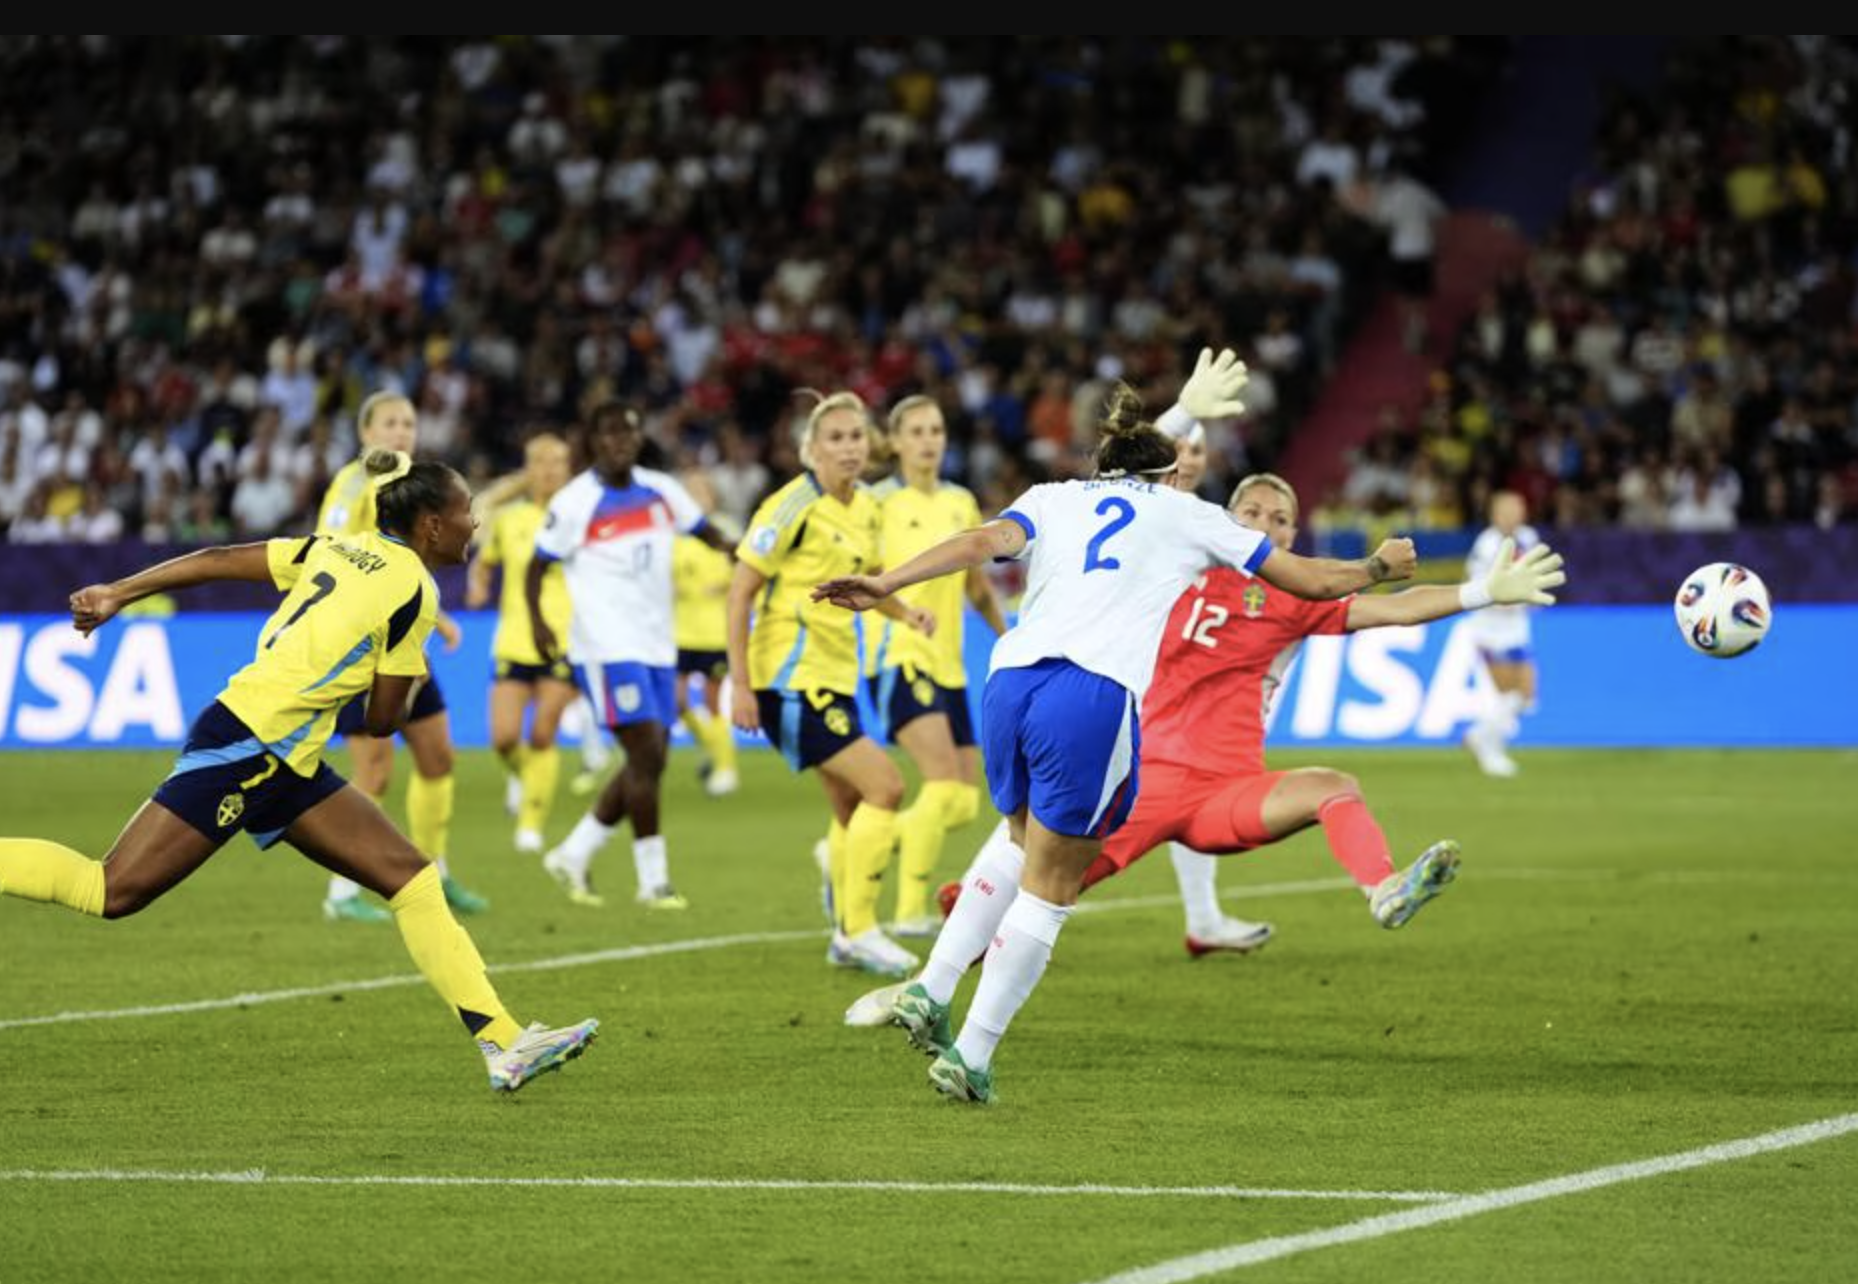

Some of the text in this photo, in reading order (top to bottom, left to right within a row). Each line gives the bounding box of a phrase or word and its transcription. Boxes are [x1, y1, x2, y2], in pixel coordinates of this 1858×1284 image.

[1083, 496, 1136, 573] 2
[266, 571, 337, 648] 7
[1182, 597, 1229, 648] 12
